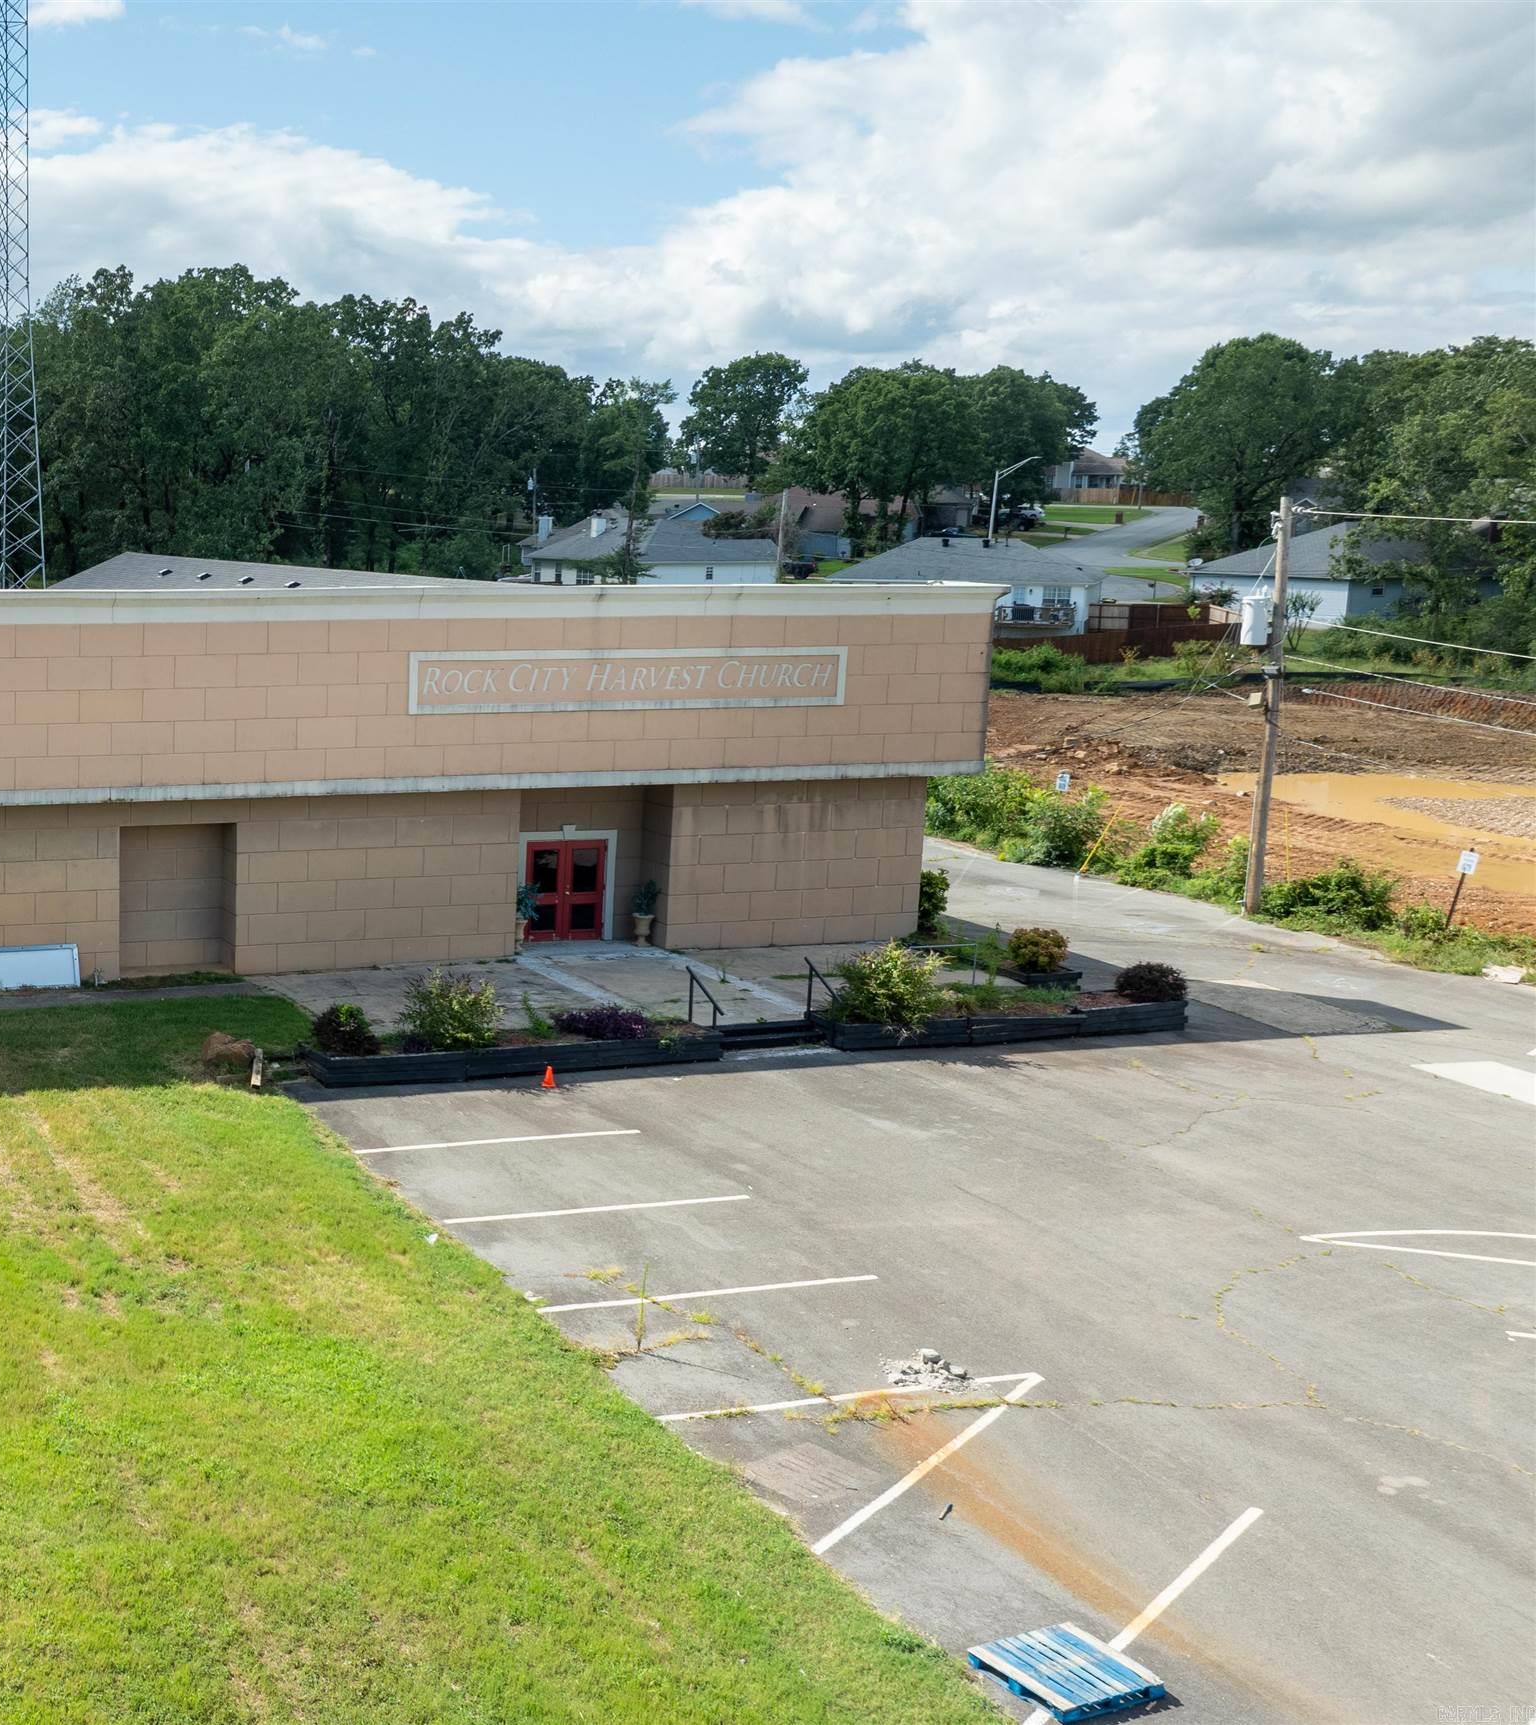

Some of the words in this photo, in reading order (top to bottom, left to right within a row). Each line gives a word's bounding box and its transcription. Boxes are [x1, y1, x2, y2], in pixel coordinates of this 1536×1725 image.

[423, 667, 504, 695] ROCK
[508, 664, 577, 692] CITY
[586, 663, 712, 691] HARVEST
[718, 660, 835, 689] CHURCH
